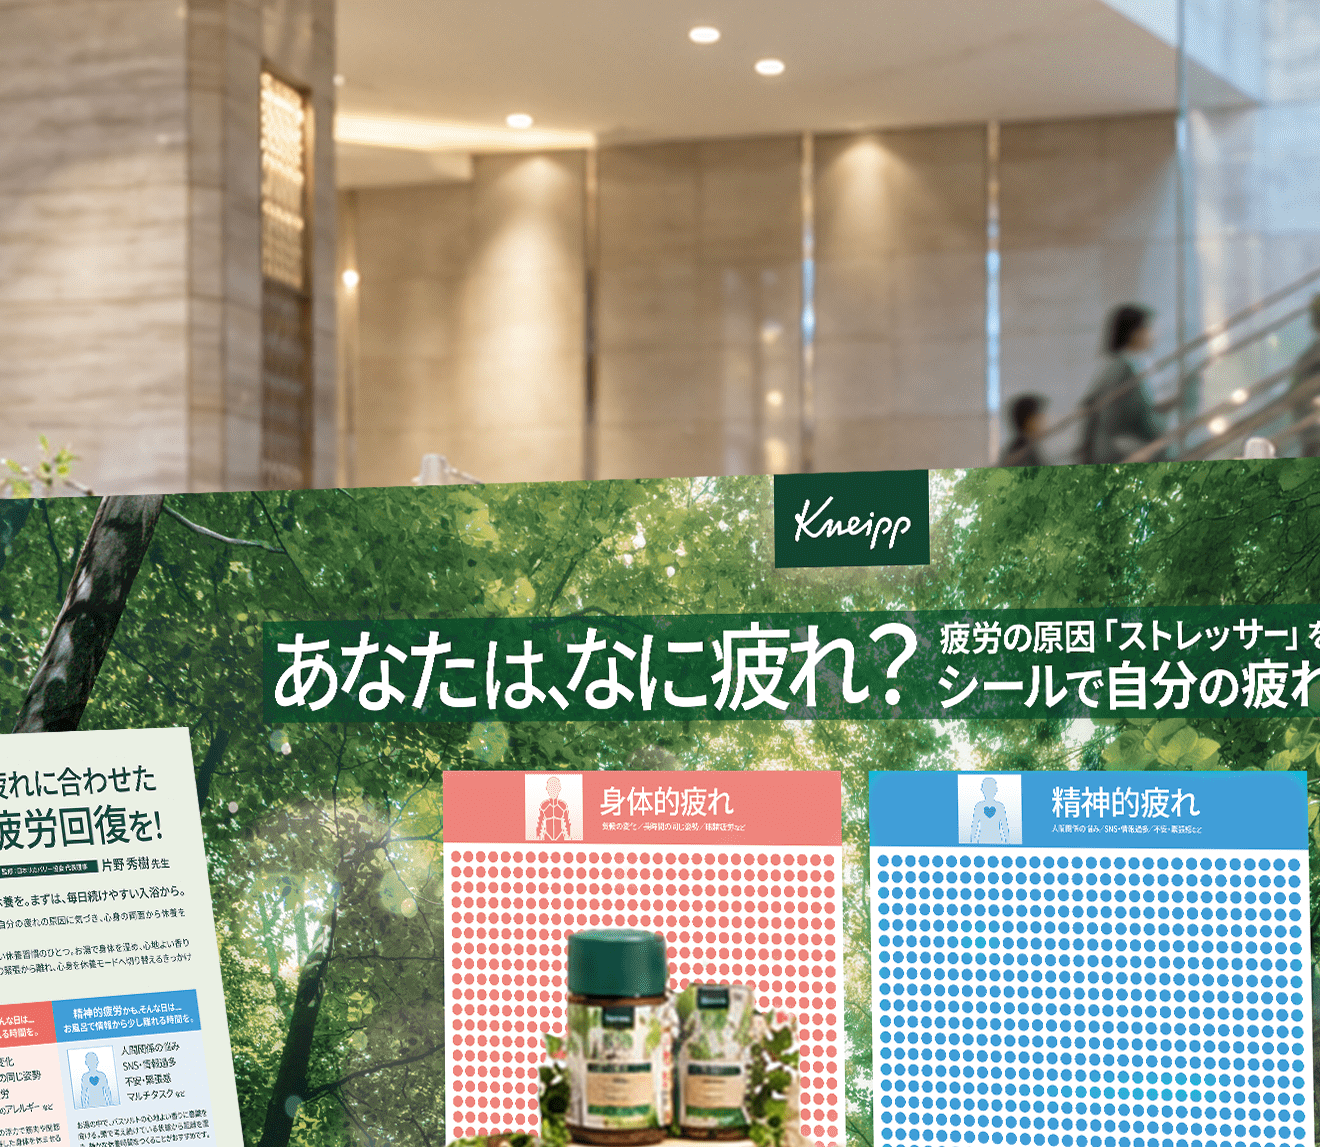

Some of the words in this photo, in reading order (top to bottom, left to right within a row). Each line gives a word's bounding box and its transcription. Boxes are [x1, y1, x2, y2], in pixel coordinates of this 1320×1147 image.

[793, 497, 913, 550] Kneipp
[275, 618, 916, 712] あなたは、なに疲れ?
[600, 786, 734, 817] 身体的疲れ
[1051, 787, 1200, 819] 精神的疲れ
[102, 858, 125, 872] 片野
[126, 856, 150, 871] 秀樹
[151, 858, 170, 870] 先生
[127, 1088, 174, 1102] マルチタスク
